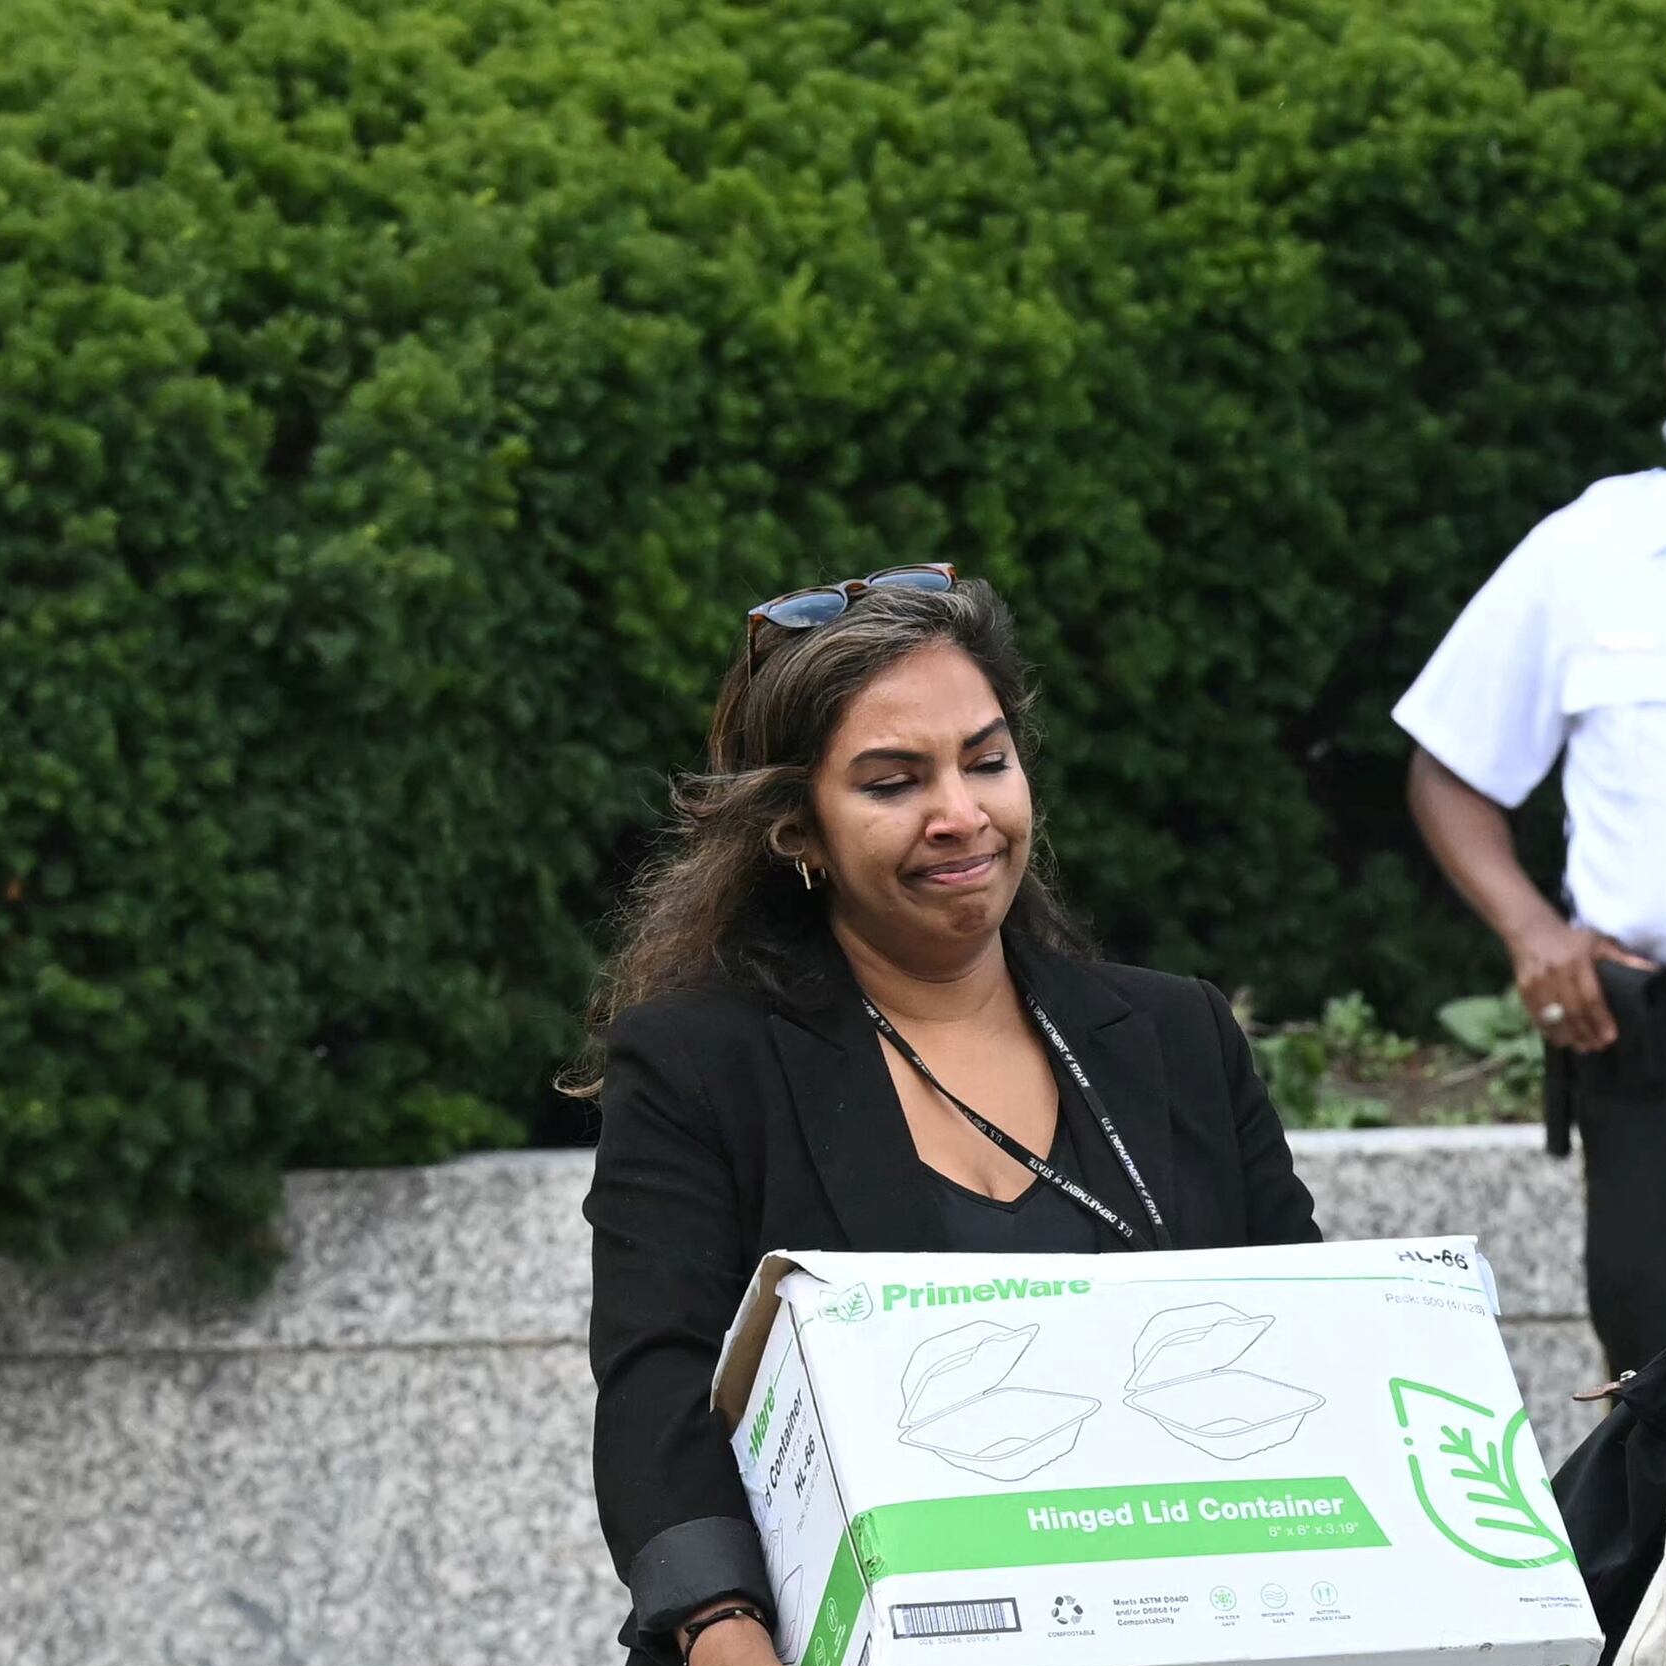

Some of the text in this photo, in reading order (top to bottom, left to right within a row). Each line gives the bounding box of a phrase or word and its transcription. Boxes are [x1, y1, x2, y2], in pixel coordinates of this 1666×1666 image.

[1034, 1006, 1069, 1053] DEPARTMENT
[1070, 1063, 1090, 1088] STATE
[1027, 1157, 1055, 1179] STATE
[1052, 1174, 1064, 1184] of
[1110, 1134, 1145, 1188] DEPARTMENT
[1145, 1199, 1162, 1225] STATE
[1061, 1180, 1118, 1223] DEPARTMENT
[1396, 1249, 1469, 1270] HL-66
[882, 1278, 1091, 1311] PrimeWare
[749, 1386, 775, 1461] Ware
[770, 1387, 802, 1489] Container
[795, 1433, 815, 1499] HL-66
[1026, 1493, 1344, 1533] Hinged Lid Container
[1139, 1597, 1162, 1605] ASTM
[1047, 1629, 1097, 1639] COMPOSTABLE
